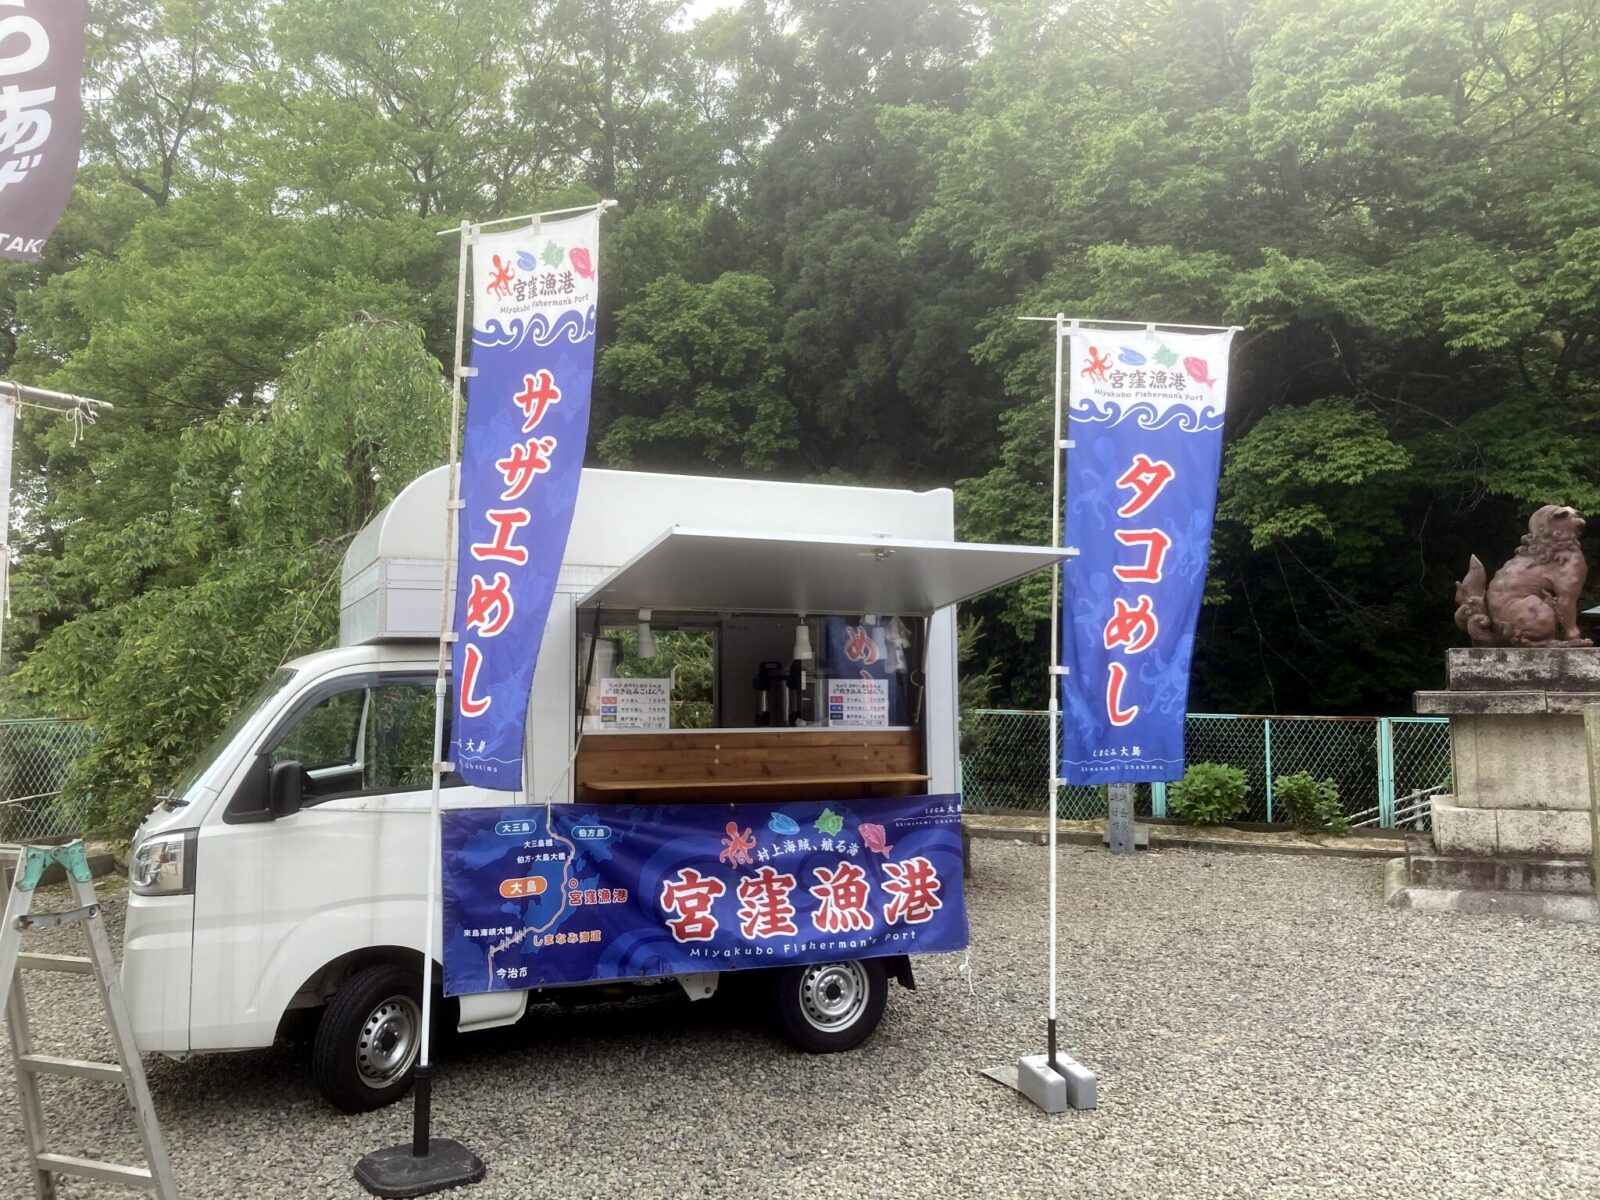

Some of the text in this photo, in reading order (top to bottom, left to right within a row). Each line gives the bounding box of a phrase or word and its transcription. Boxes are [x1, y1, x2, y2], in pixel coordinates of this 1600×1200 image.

[513, 270, 575, 302] 宮窪漁港
[500, 293, 589, 314] Miyakubo Fisherman's Port
[1109, 370, 1187, 391] 宮窪漁港
[1093, 388, 1204, 402] Miyakubo Fisherman's Port
[460, 369, 561, 717] サザエめし
[1104, 453, 1176, 726] タコめし
[502, 822, 531, 833] 大三島
[578, 827, 606, 838] 伯方島
[523, 838, 554, 849] 大三島橋
[510, 880, 538, 895] 大島
[568, 888, 629, 906] 宮窪漁港
[660, 857, 943, 943] 宮窪漁港
[463, 926, 514, 938] 来島海峡大橋
[532, 930, 603, 948] しまなみ海道
[690, 930, 917, 957] Miyakubo Fisherman's Port
[496, 966, 528, 980] 今治市
